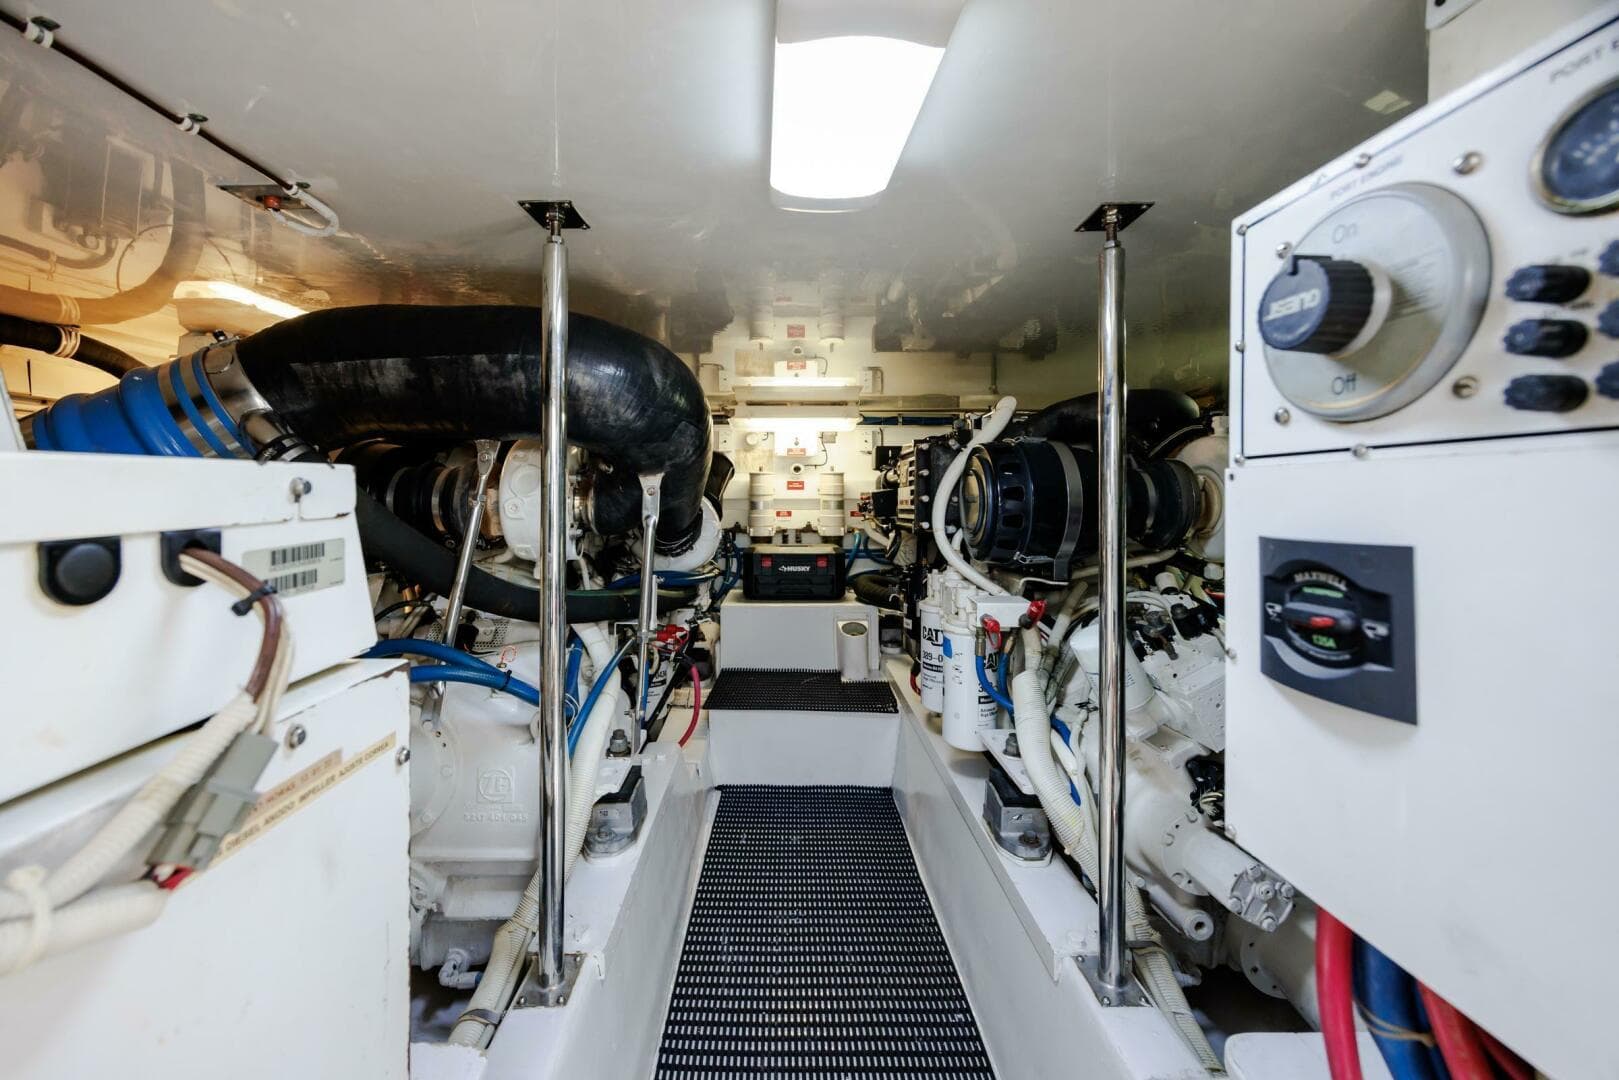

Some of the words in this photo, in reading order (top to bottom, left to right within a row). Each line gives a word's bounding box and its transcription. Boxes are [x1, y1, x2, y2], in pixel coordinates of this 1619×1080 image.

[1332, 223, 1358, 244] On
[1331, 373, 1358, 396] Off
[1294, 571, 1348, 591] MAXWELL
[922, 626, 941, 643] CAT
